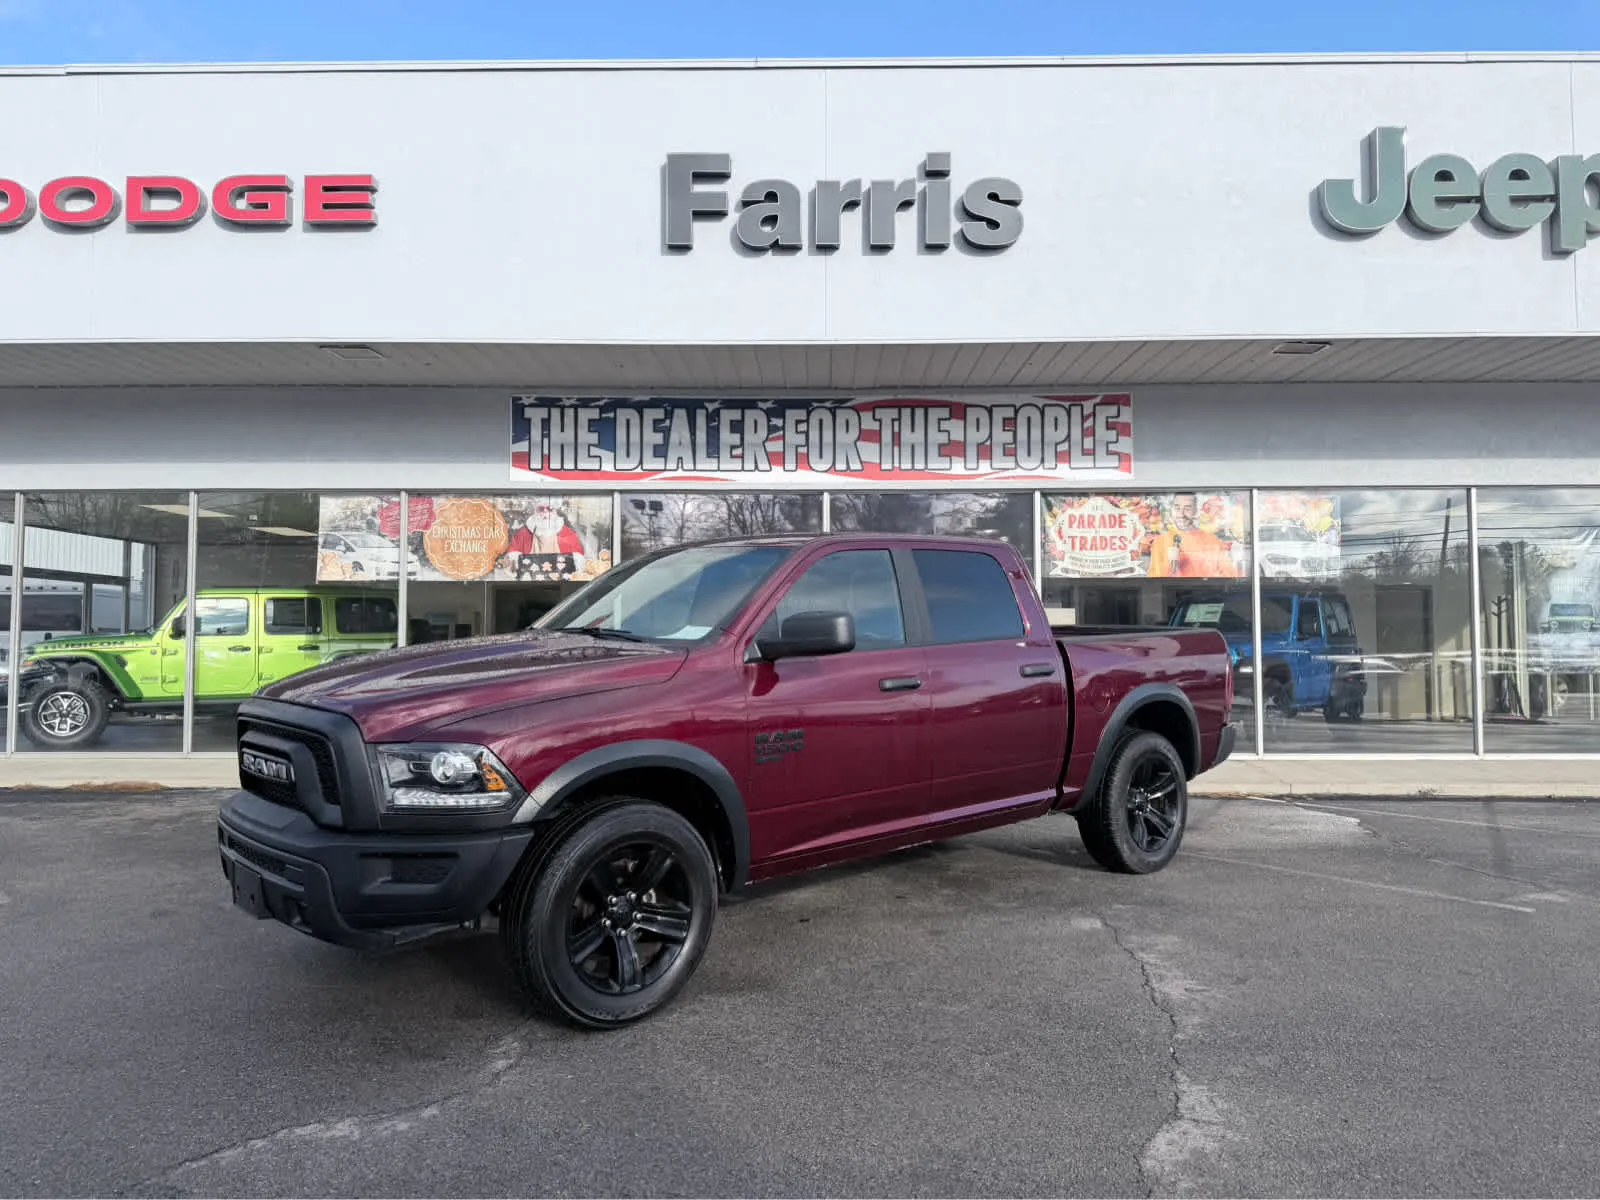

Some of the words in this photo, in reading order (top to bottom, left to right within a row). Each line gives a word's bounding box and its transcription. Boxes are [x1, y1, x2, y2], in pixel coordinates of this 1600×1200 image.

[661, 152, 1024, 254] Farris
[1312, 126, 1600, 254] Jeep
[524, 406, 602, 471] THE
[614, 406, 772, 472] DEALER
[783, 406, 865, 472] FOR
[873, 405, 952, 471] THE
[964, 403, 1121, 471] PEOPLE
[433, 526, 480, 539] CHRISTMAS
[1068, 513, 1128, 529] PARADE
[1067, 535, 1129, 552] TRADES
[242, 752, 288, 780] RAM
